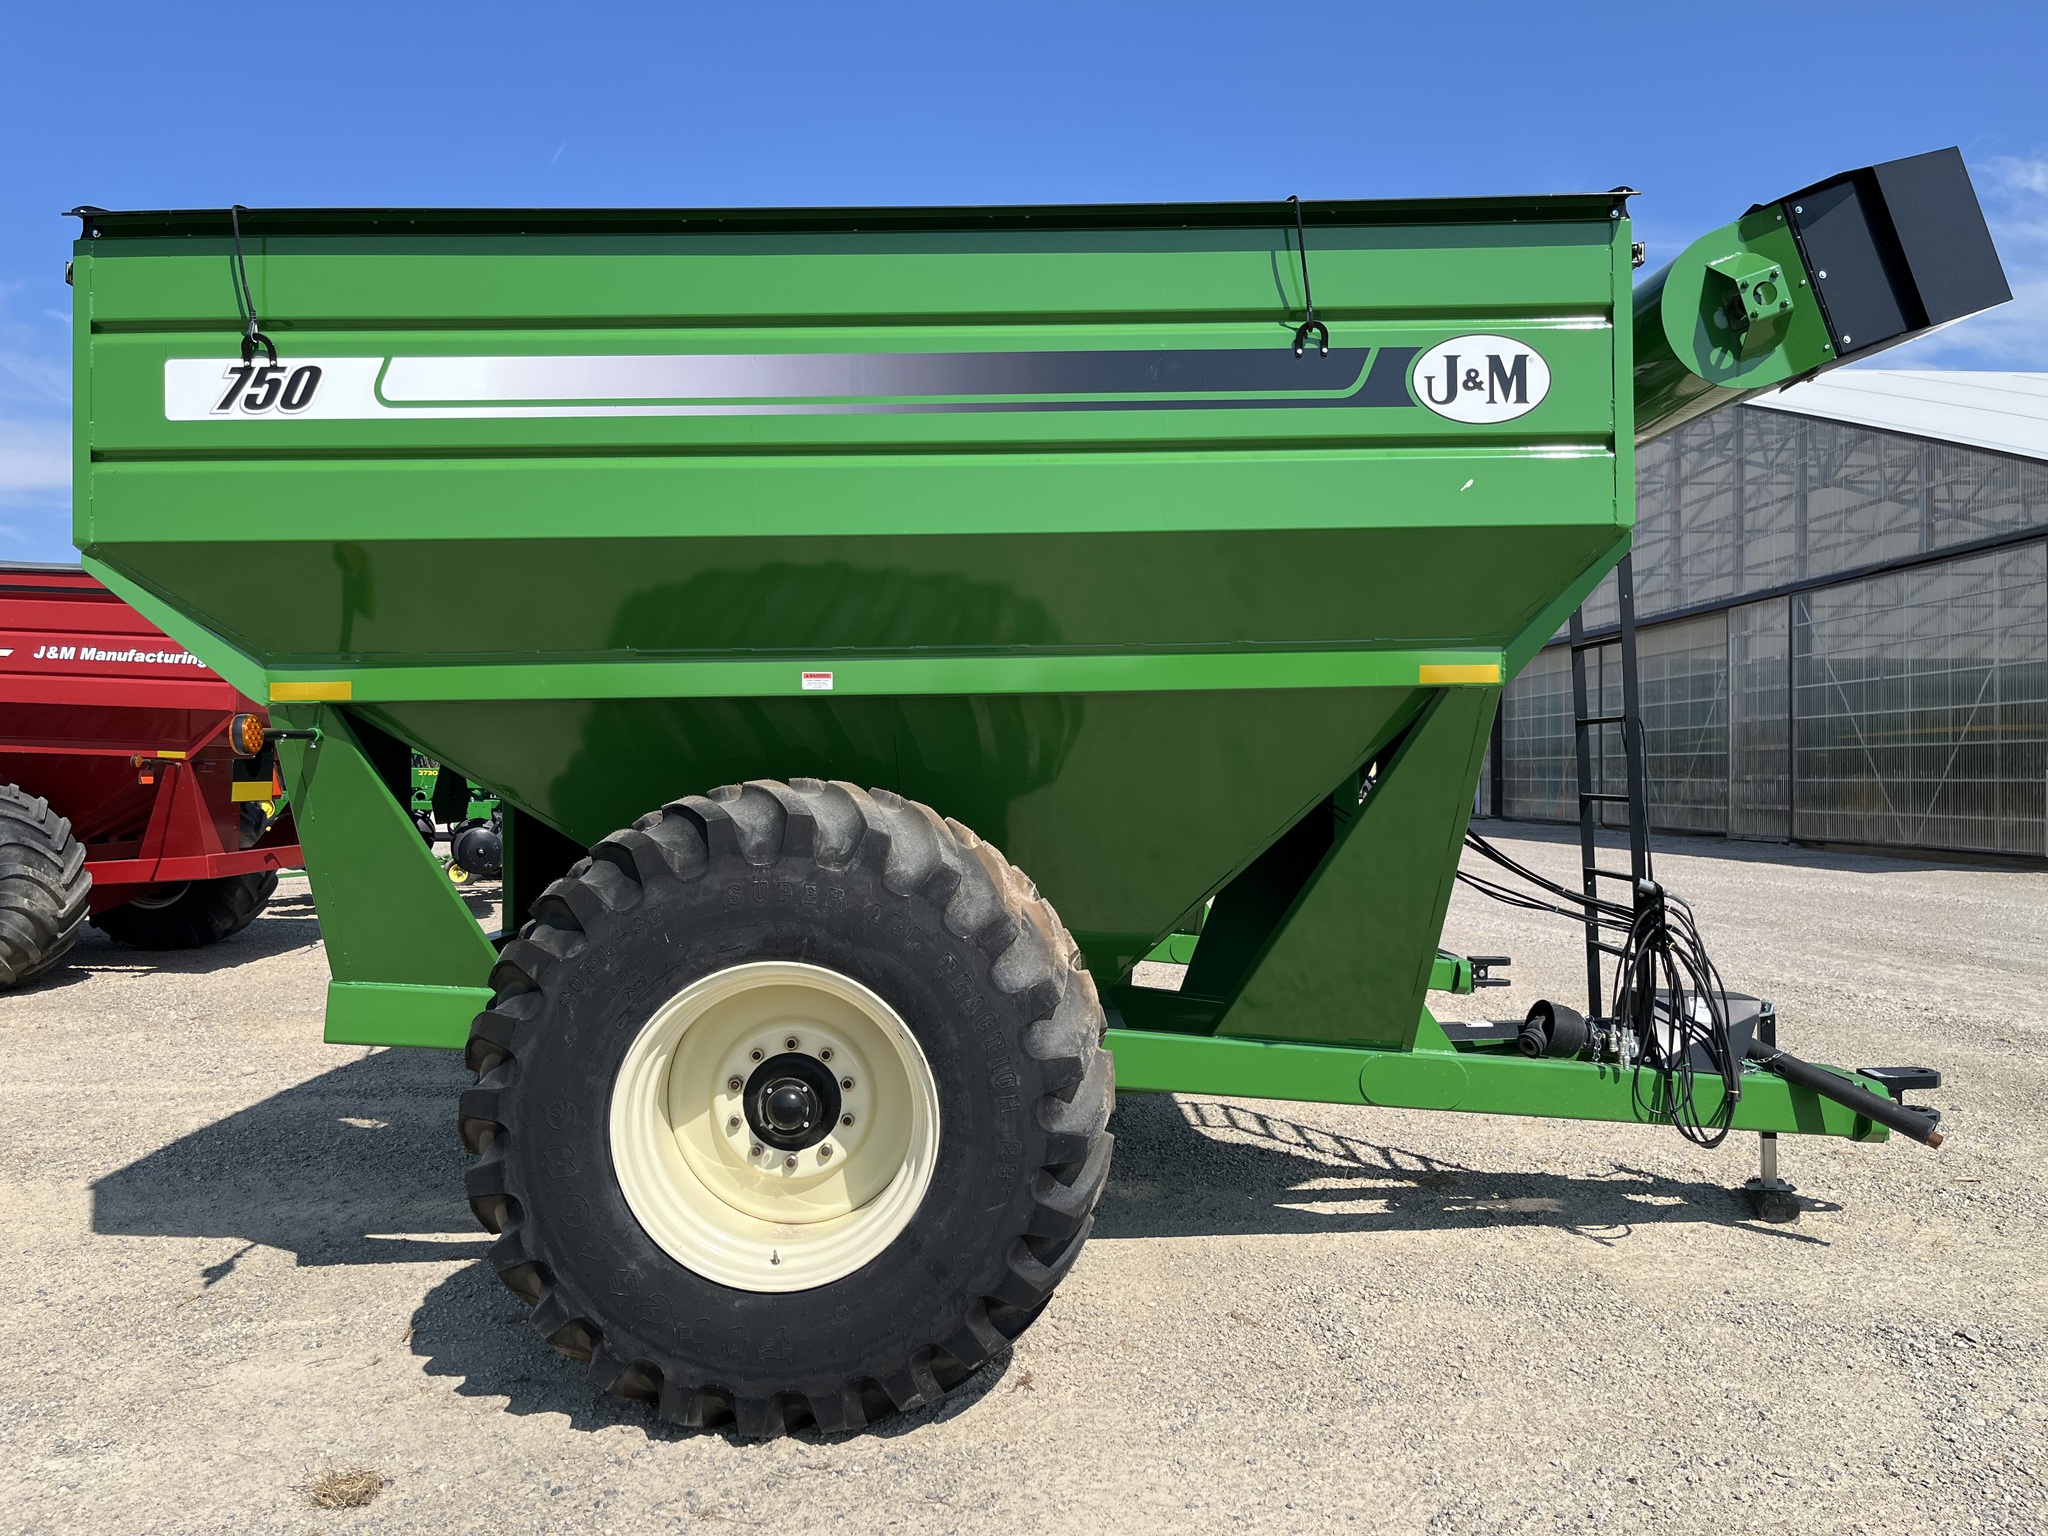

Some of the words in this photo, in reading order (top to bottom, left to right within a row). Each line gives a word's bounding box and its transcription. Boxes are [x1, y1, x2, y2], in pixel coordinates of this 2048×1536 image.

[213, 365, 323, 412] 750
[1423, 354, 1530, 405] J&M
[33, 645, 76, 660] J&M
[727, 881, 845, 911] SUPER
[864, 903, 922, 951] ALL
[936, 951, 1021, 1115] TRACTION
[543, 1099, 794, 1361] Firestone
